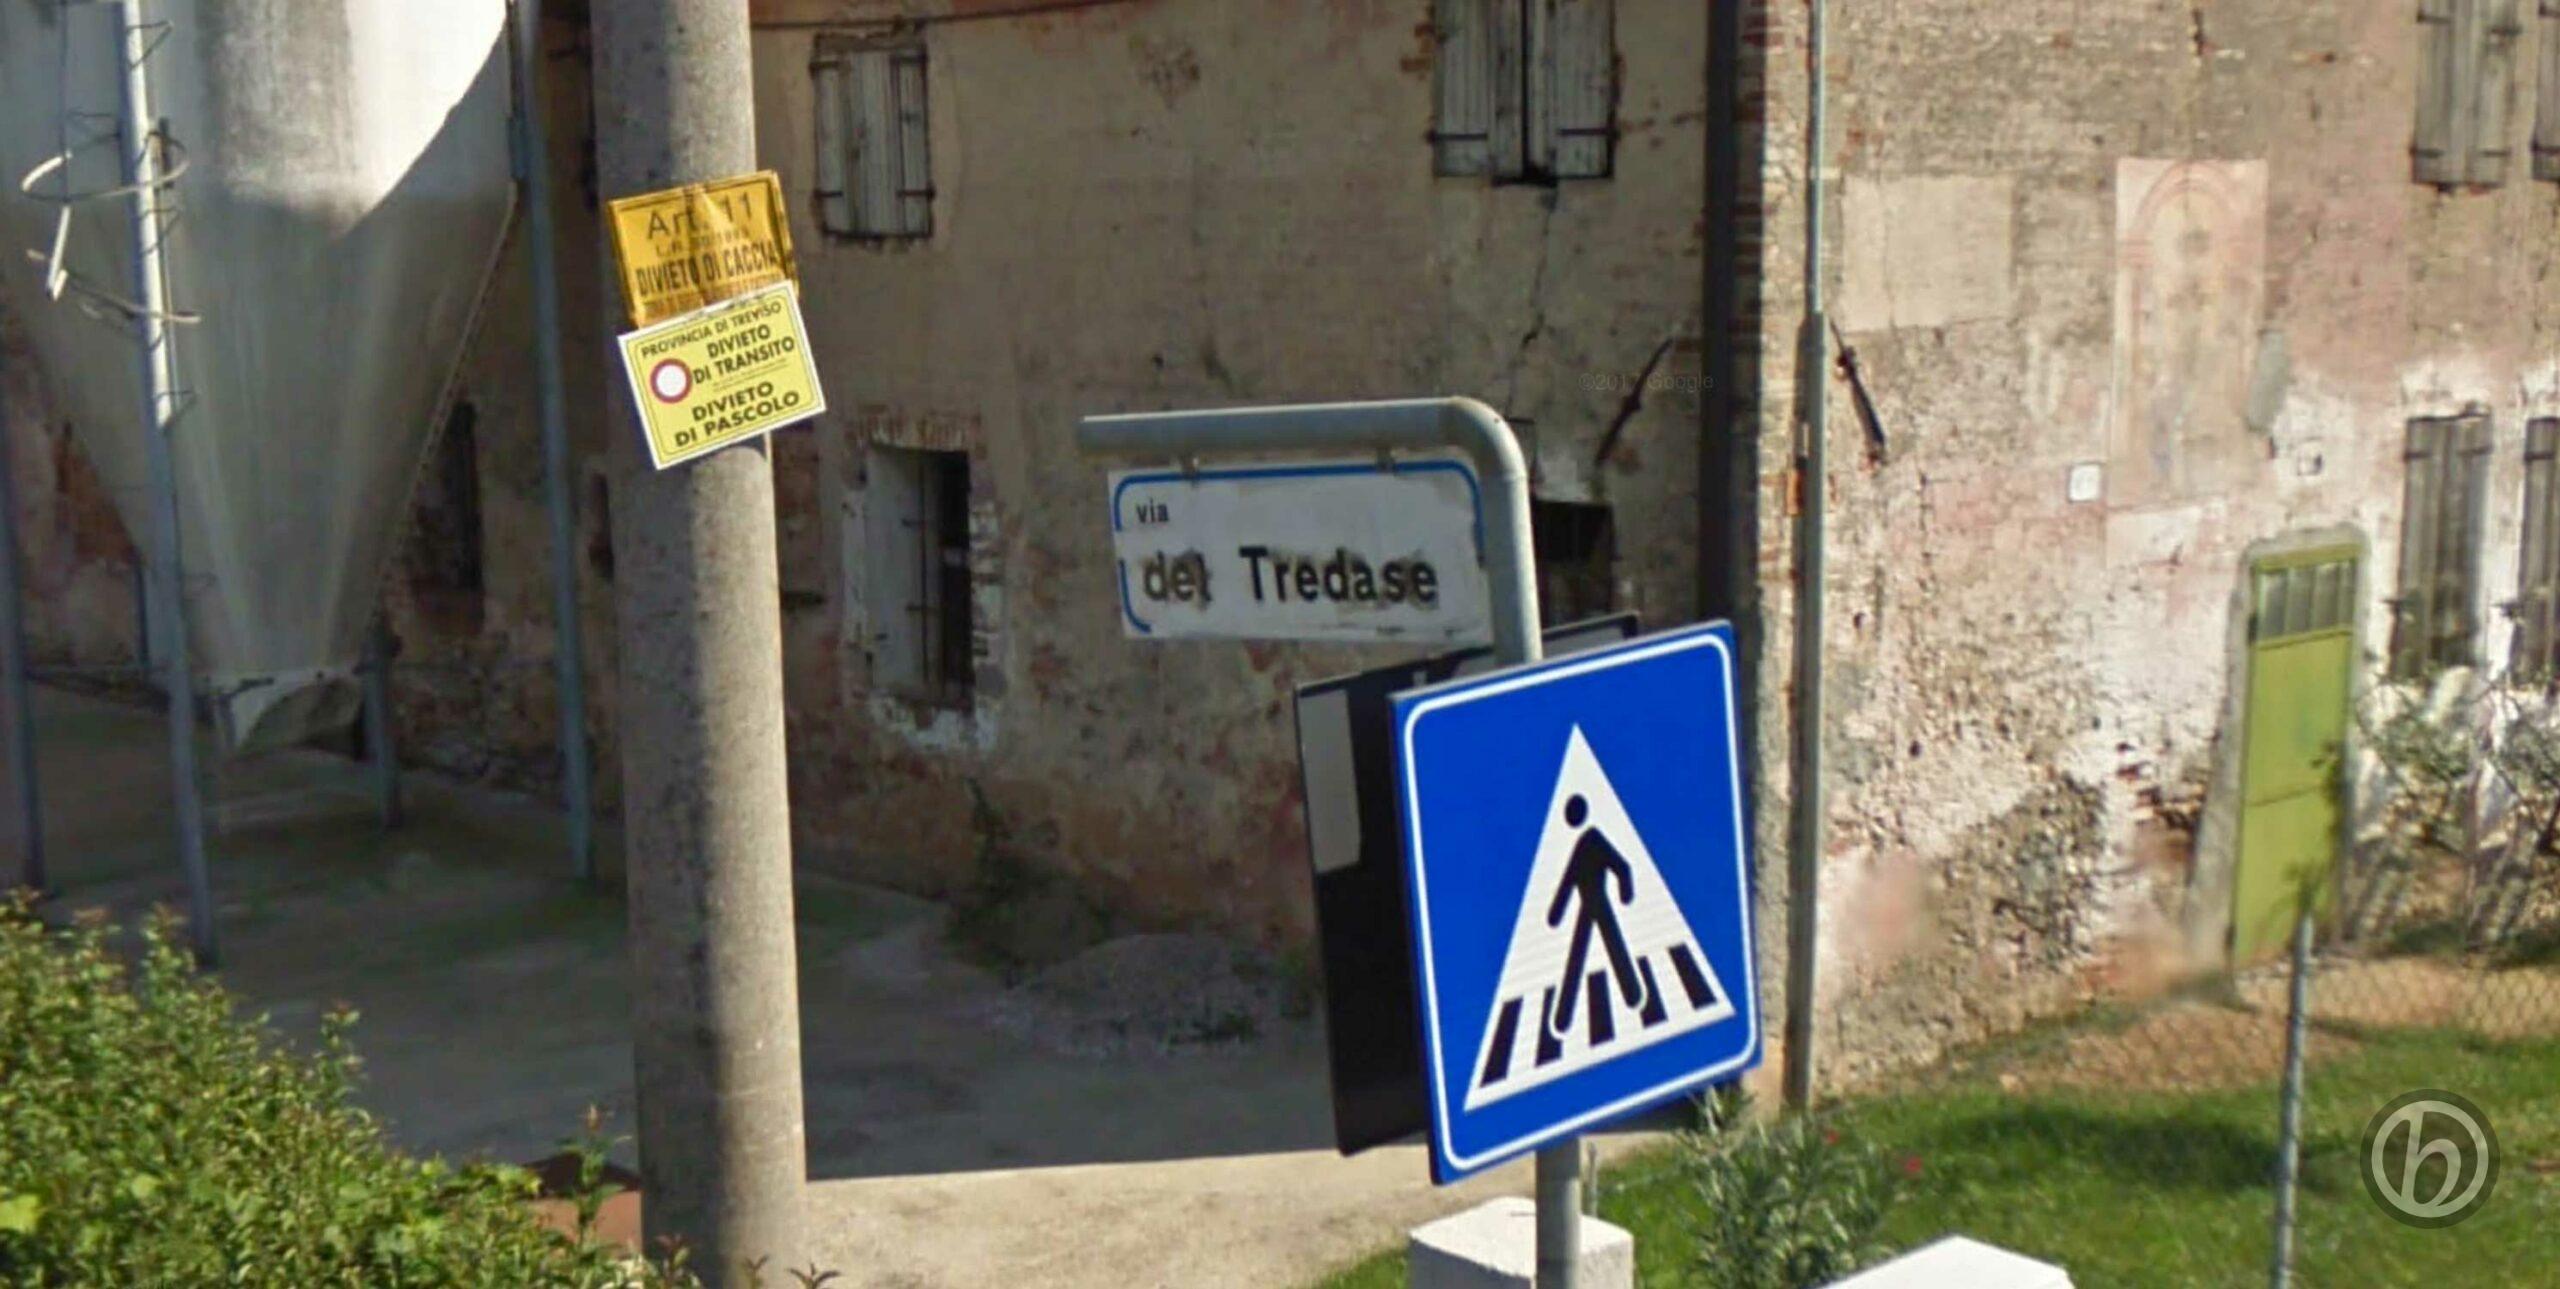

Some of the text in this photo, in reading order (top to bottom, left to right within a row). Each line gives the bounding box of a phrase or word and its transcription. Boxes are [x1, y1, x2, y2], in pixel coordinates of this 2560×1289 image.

[720, 192, 752, 223] 11
[636, 240, 779, 296] DIVIETO DI CACCIA
[641, 301, 782, 359] PROVINCIA DI TREVISO
[706, 323, 771, 359] DIVIETO
[693, 367, 712, 385] DI
[714, 335, 796, 377] TRANSITO
[674, 390, 801, 447] DI PASCOLO
[691, 381, 774, 422] DIVIETO
[1136, 498, 1170, 524] via
[1238, 545, 1439, 603] Tredase
